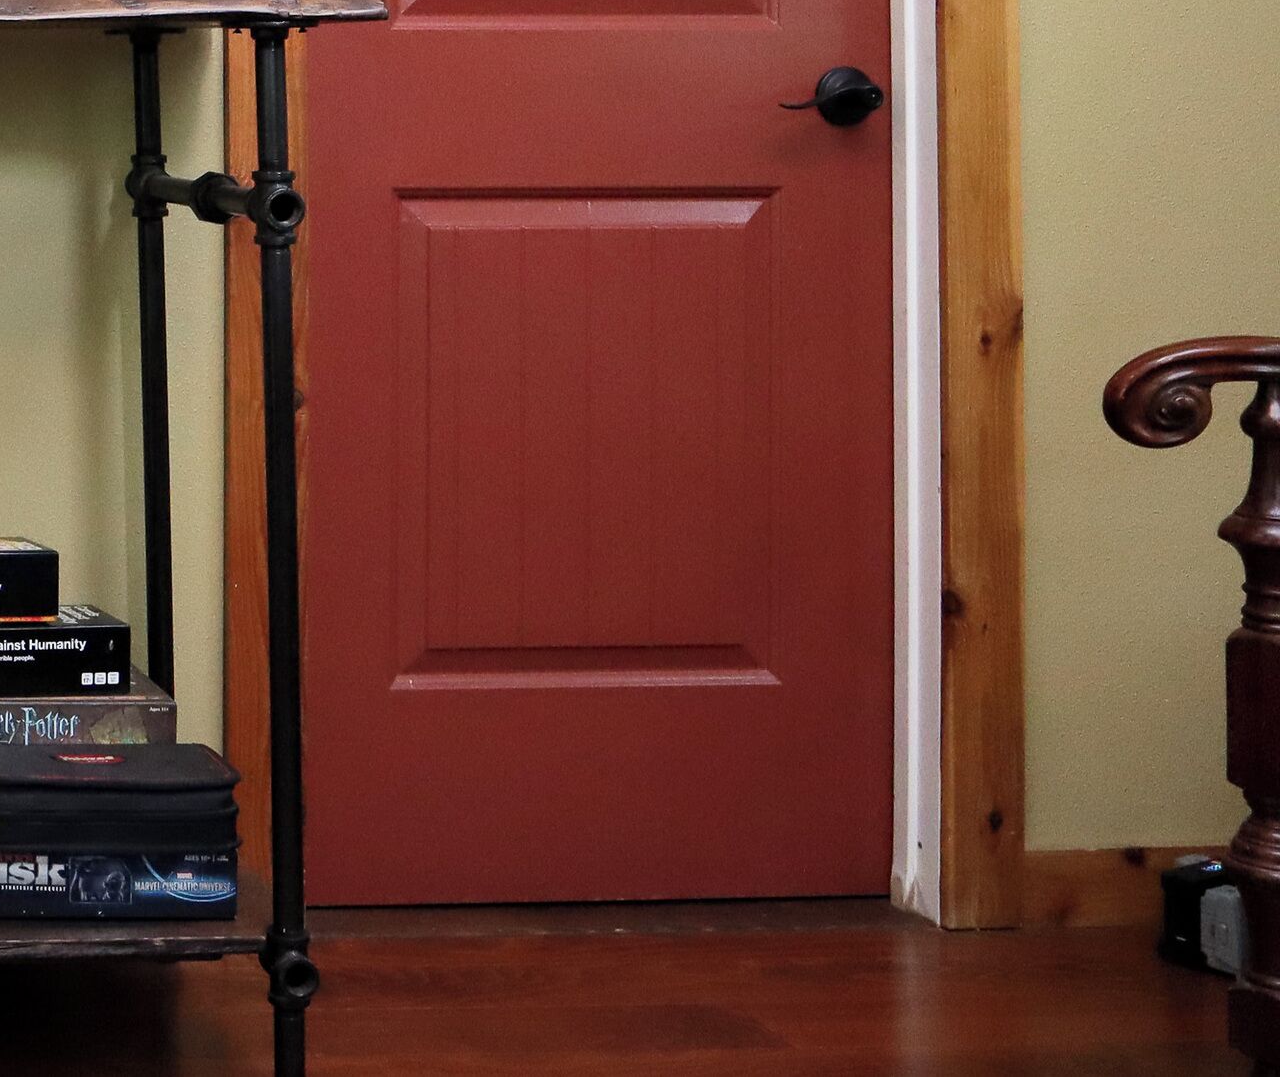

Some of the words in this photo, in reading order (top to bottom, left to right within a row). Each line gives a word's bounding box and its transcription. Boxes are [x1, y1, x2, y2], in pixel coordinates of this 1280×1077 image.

[29, 638, 87, 652] Humanity
[21, 707, 80, 745] Potter
[134, 882, 160, 891] MARVEL
[162, 882, 198, 891] CINEMATIC
[199, 882, 231, 891] UNIVERSE
